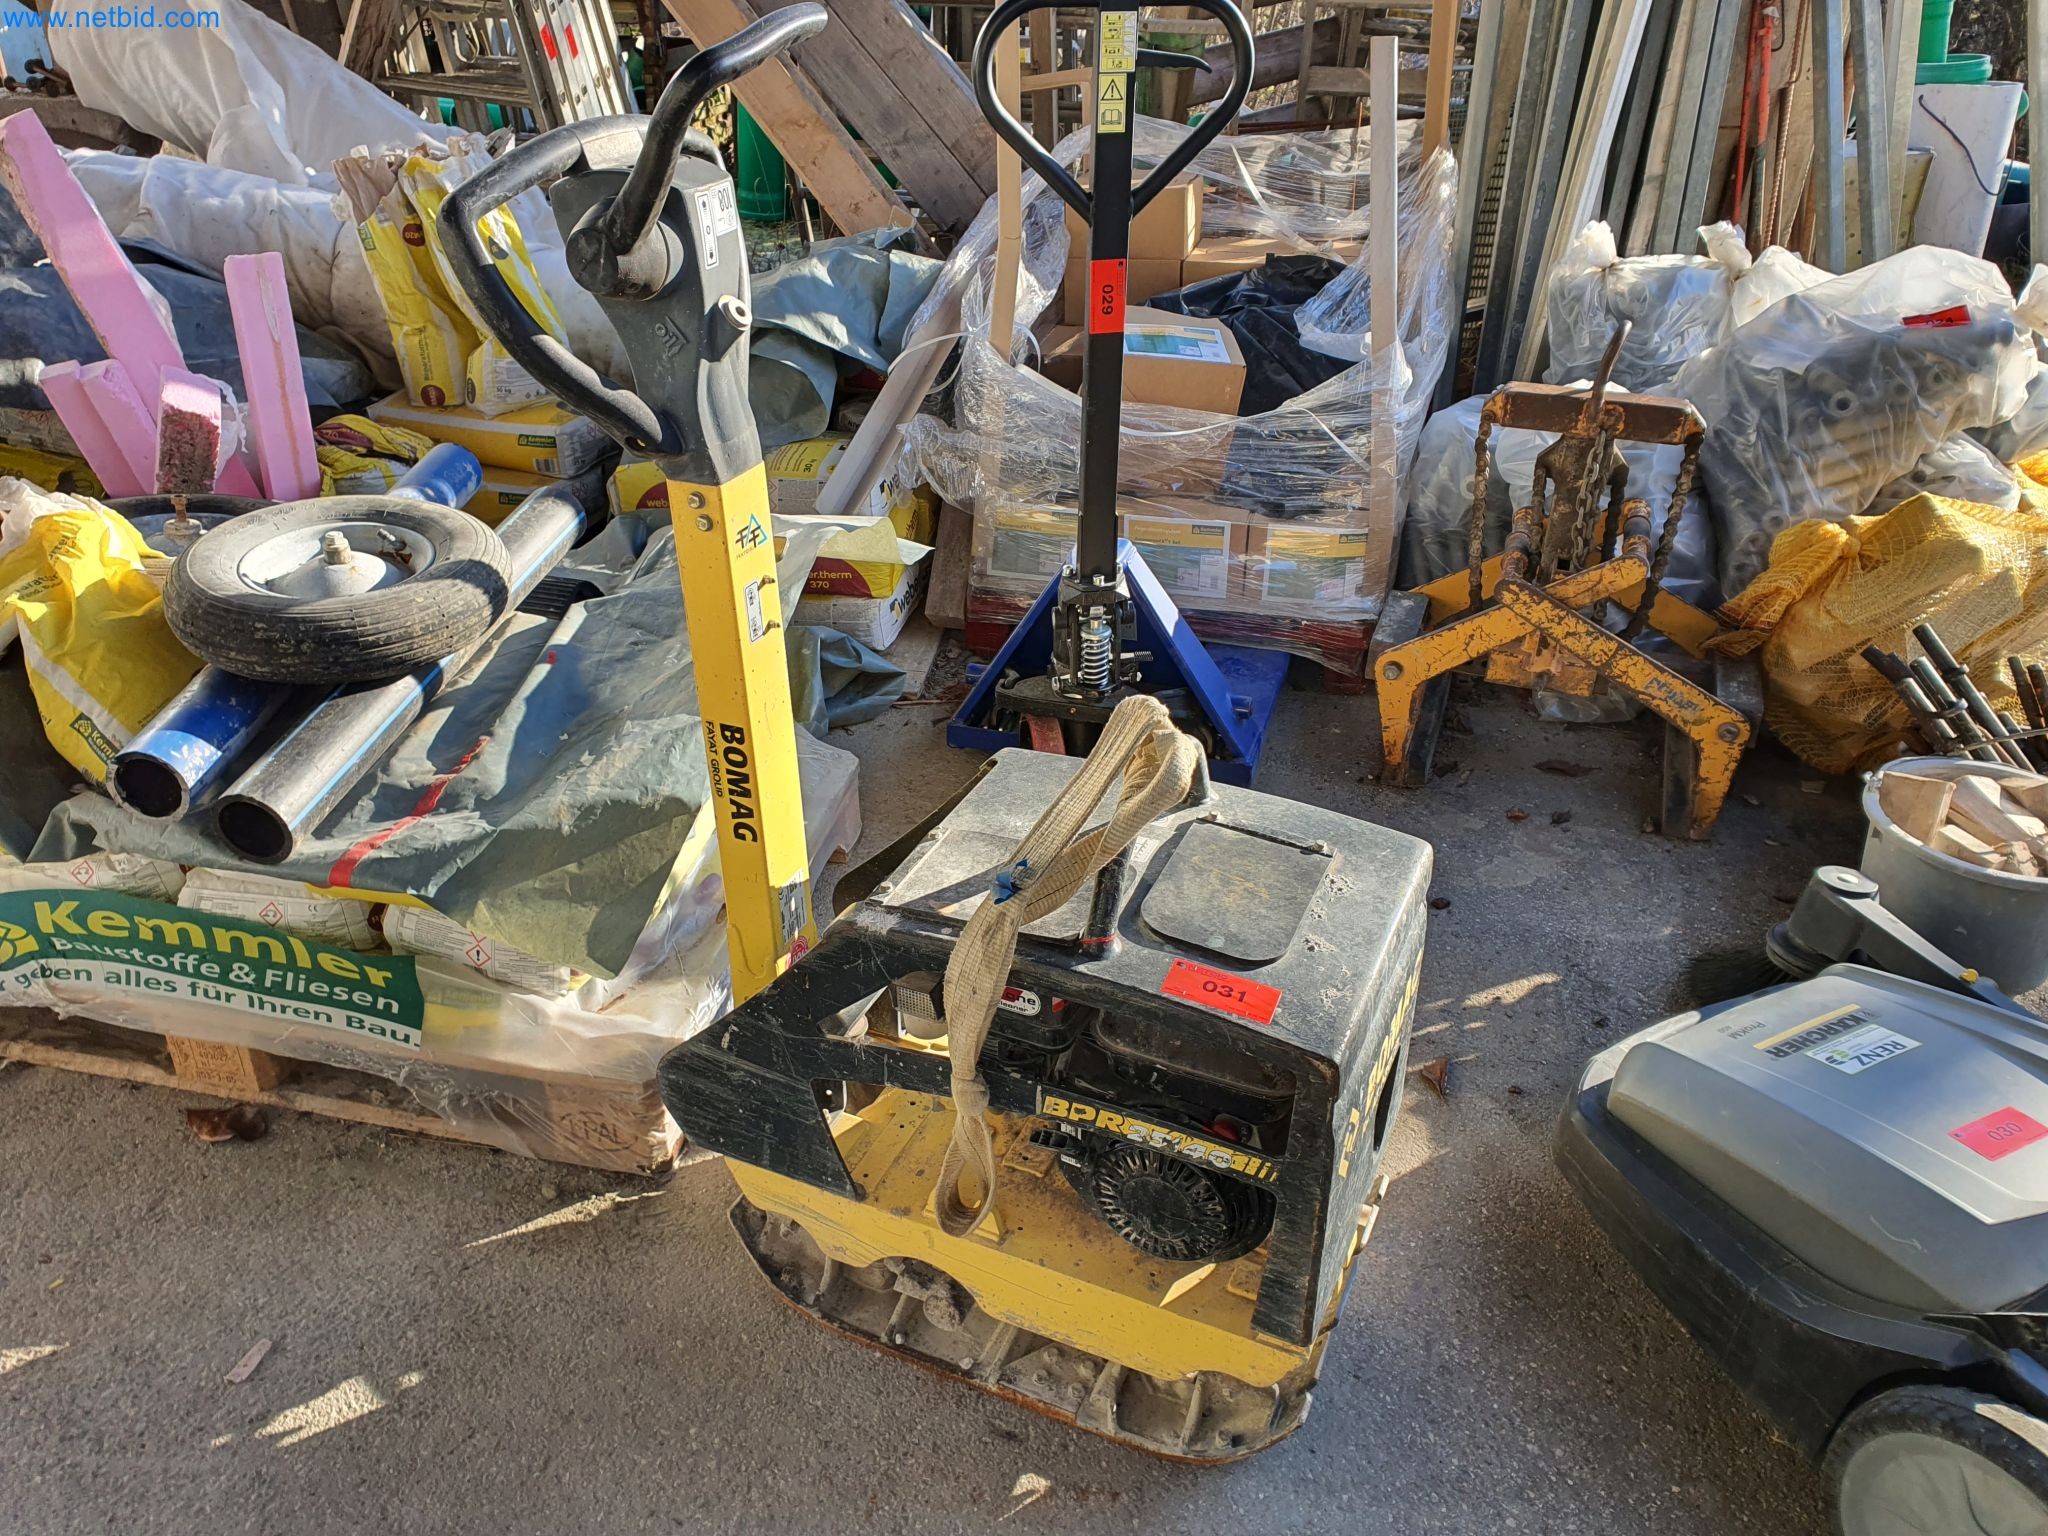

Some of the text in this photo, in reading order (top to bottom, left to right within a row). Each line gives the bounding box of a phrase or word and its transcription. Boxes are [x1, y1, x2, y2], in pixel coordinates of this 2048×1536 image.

[1102, 284, 1114, 315] 029
[803, 463, 813, 473] 30
[646, 498, 668, 508] web
[809, 581, 830, 589] 370
[705, 720, 724, 798] FAYAT GROUP
[720, 723, 758, 843] BOMAG
[34, 901, 393, 988] Kemmler
[51, 937, 400, 1015] Baustoffe & Fliesen
[1202, 980, 1247, 1003] 031
[15, 963, 93, 989] geben
[104, 969, 178, 993] alles
[187, 980, 237, 1003] für
[247, 995, 333, 1024] Ihren
[345, 1014, 421, 1048] Bau.
[1764, 1013, 1868, 1059] KÄRCHER
[1855, 1039, 1908, 1067] RENZ
[1043, 1095, 1126, 1134] BPR
[1987, 1121, 2022, 1141] 030
